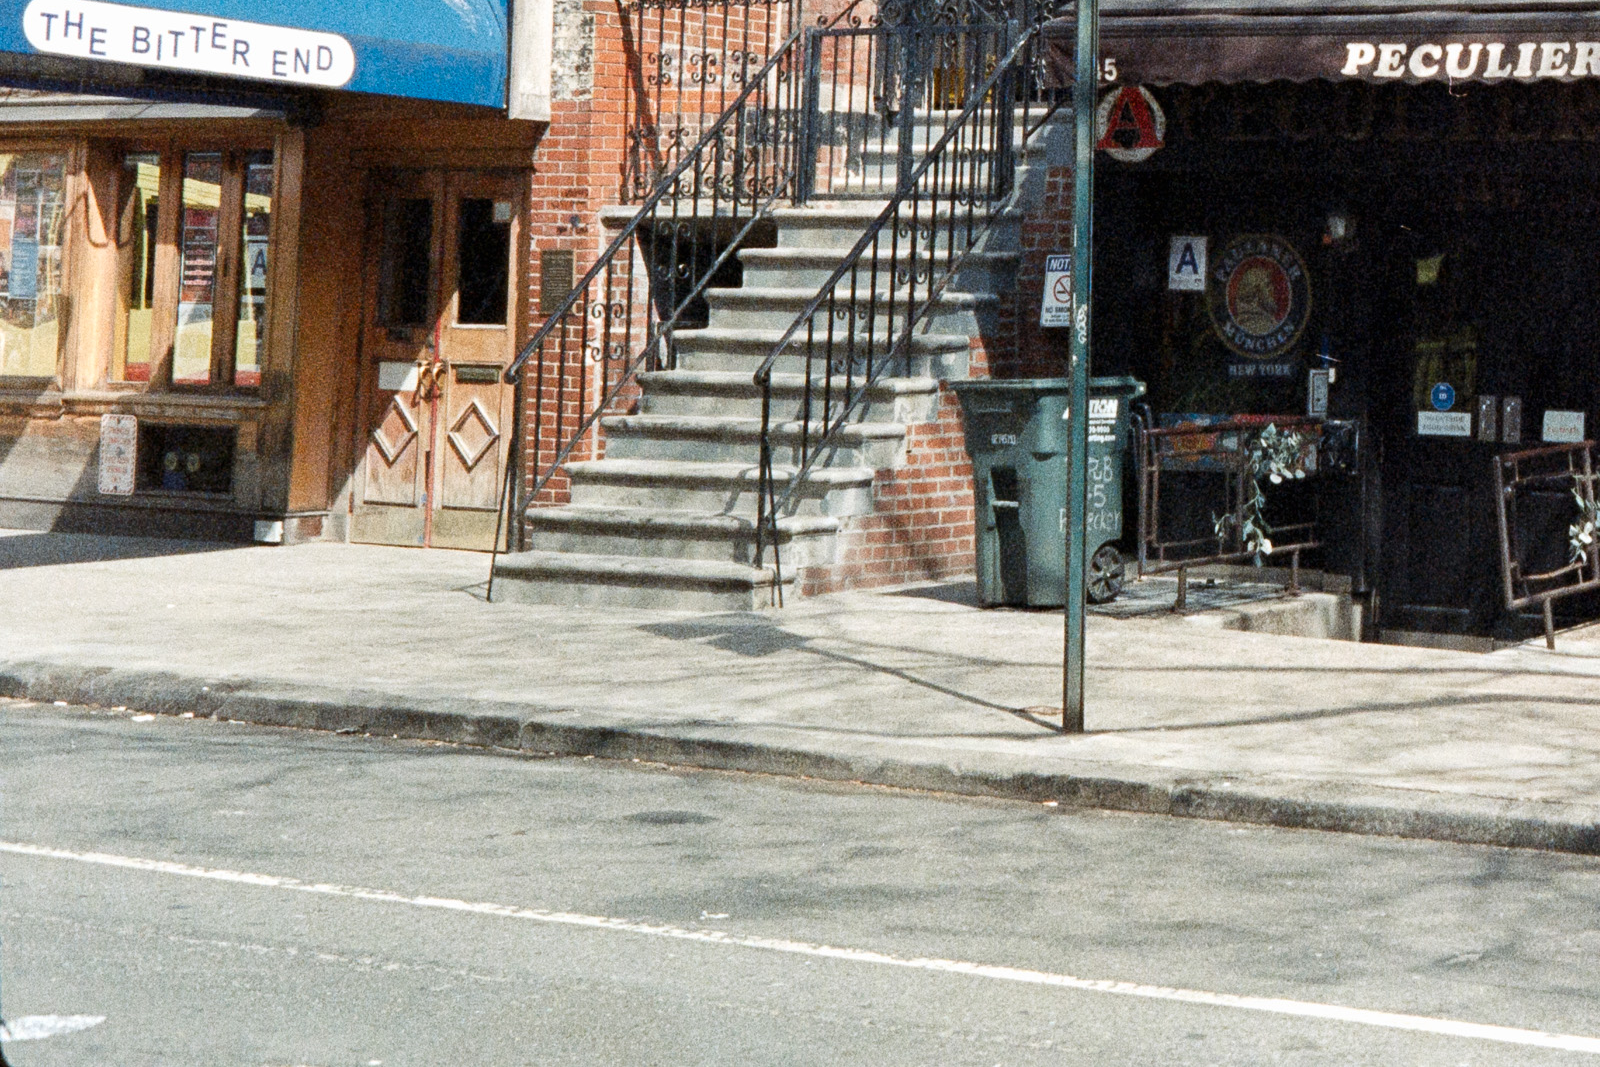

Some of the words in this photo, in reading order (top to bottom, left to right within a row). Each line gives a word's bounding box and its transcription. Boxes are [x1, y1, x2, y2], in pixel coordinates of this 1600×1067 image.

[40, 11, 107, 56] THE
[132, 22, 251, 67] BITTER
[272, 45, 334, 77] END
[252, 249, 267, 275] A
[1175, 242, 1199, 275] A
[1228, 364, 1257, 376] NEW
[1258, 364, 1291, 376] YORK
